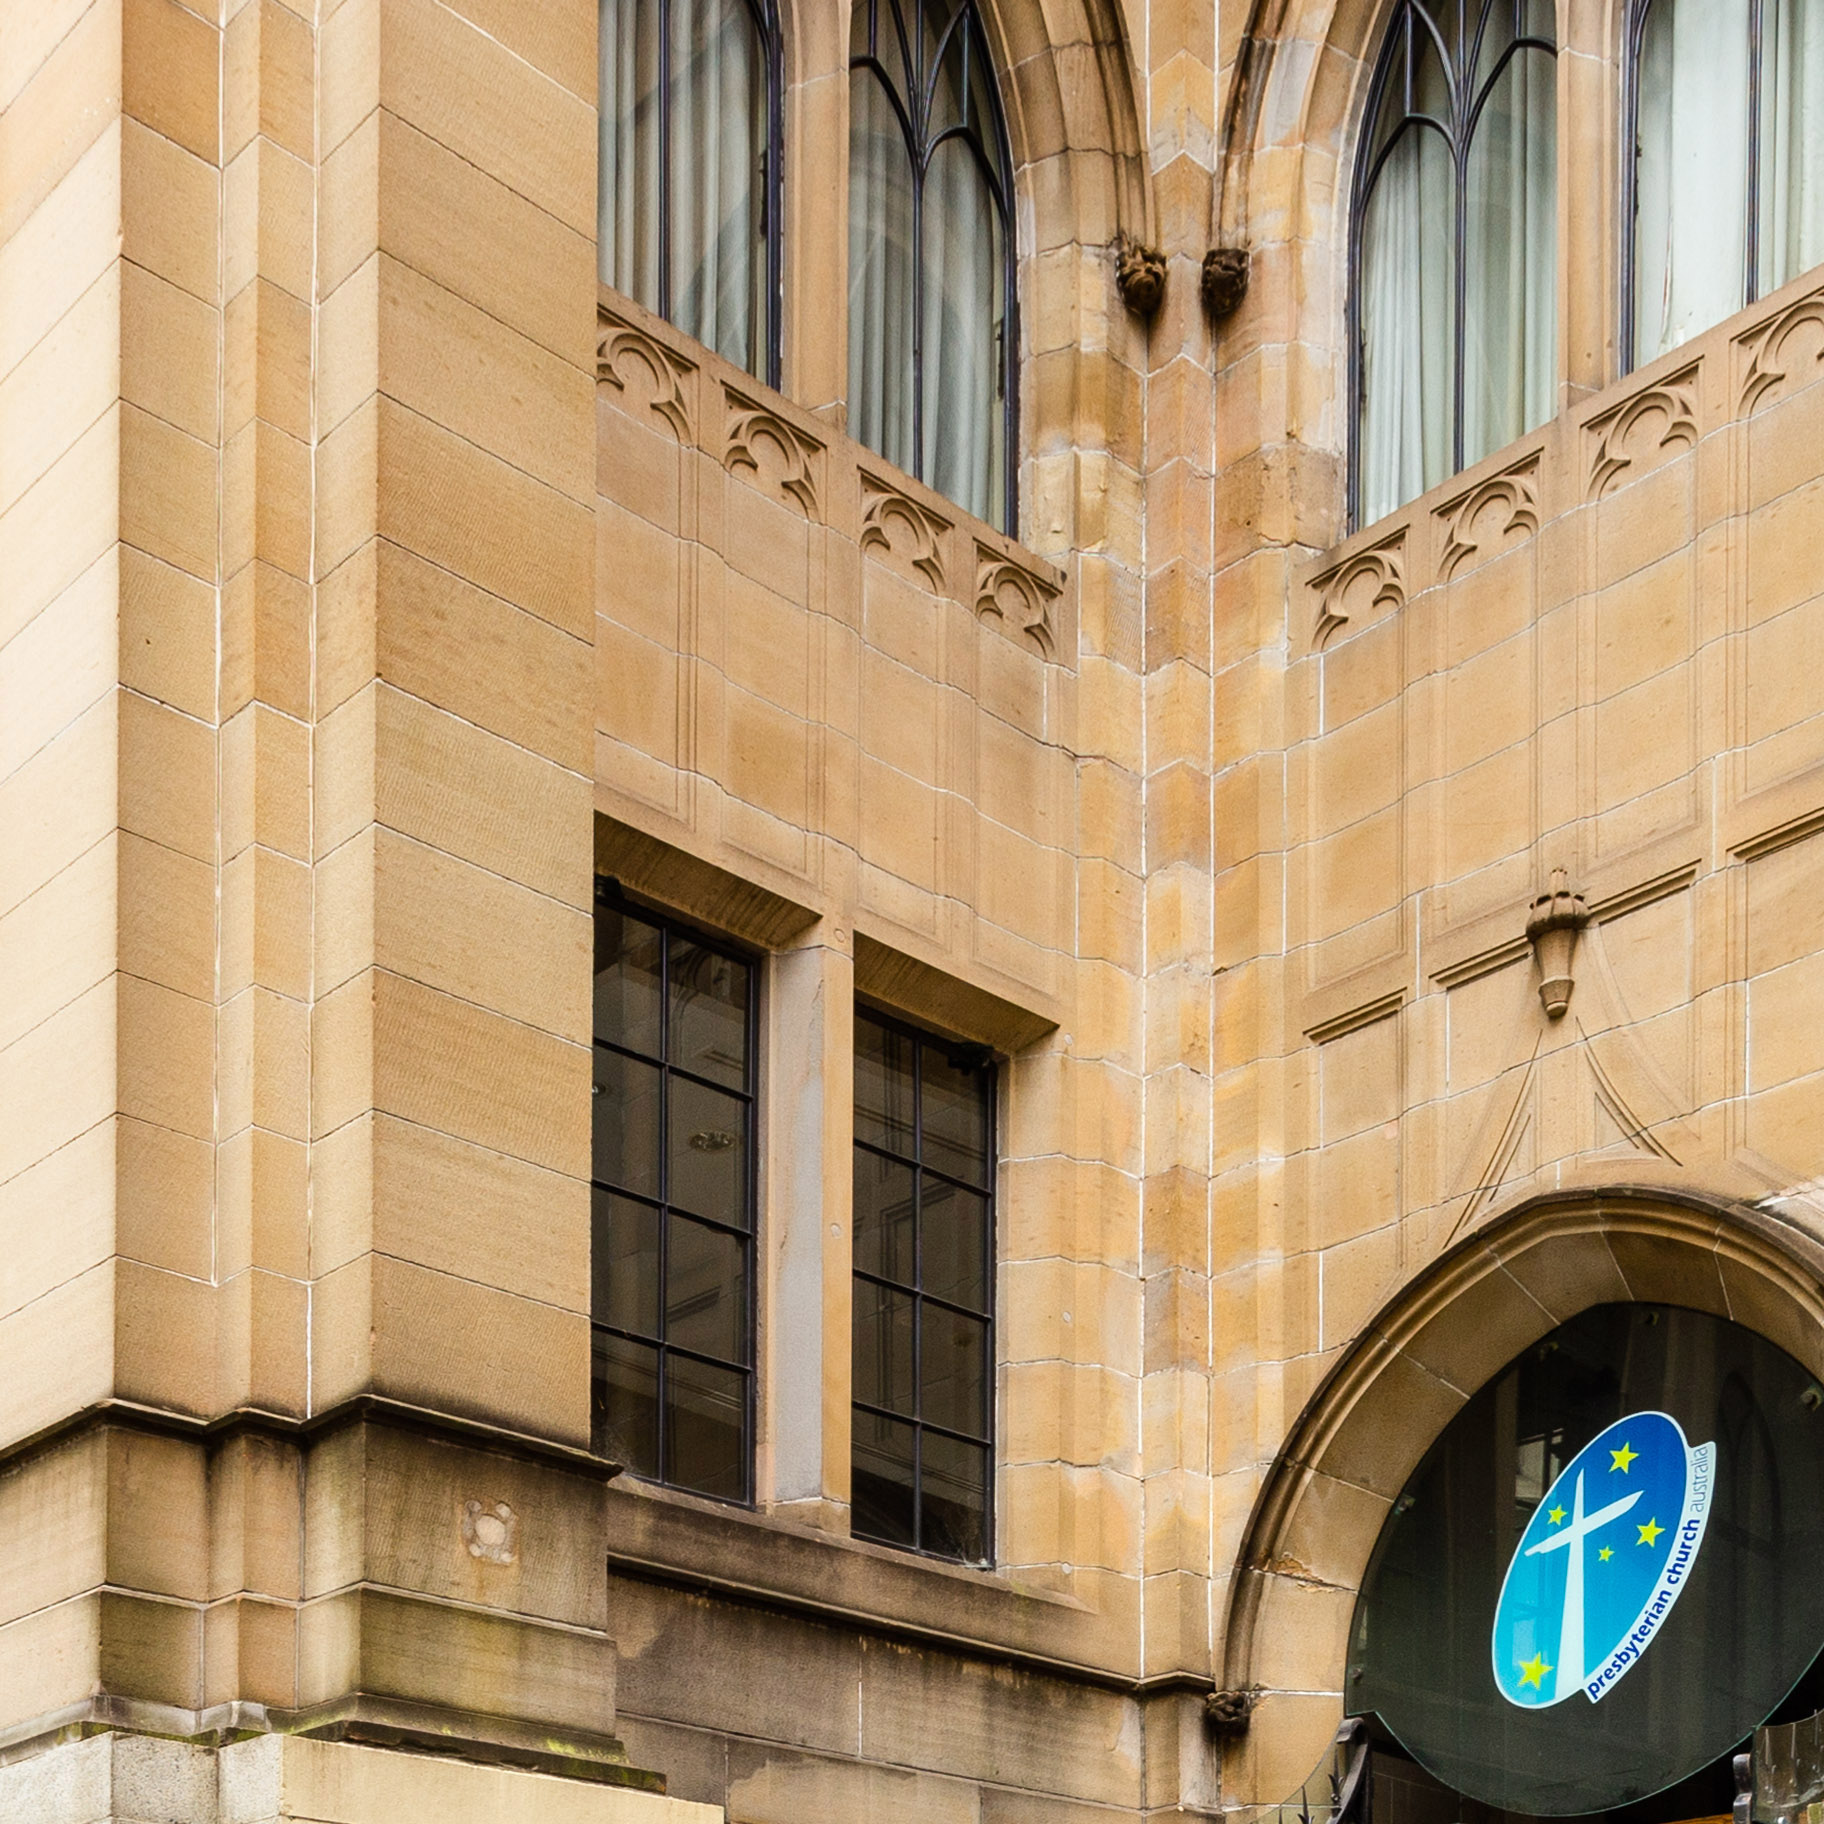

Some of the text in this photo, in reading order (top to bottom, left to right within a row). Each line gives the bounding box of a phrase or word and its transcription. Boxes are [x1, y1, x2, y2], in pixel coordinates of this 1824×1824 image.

[1587, 1446, 1708, 1699] presbyterian church australia
